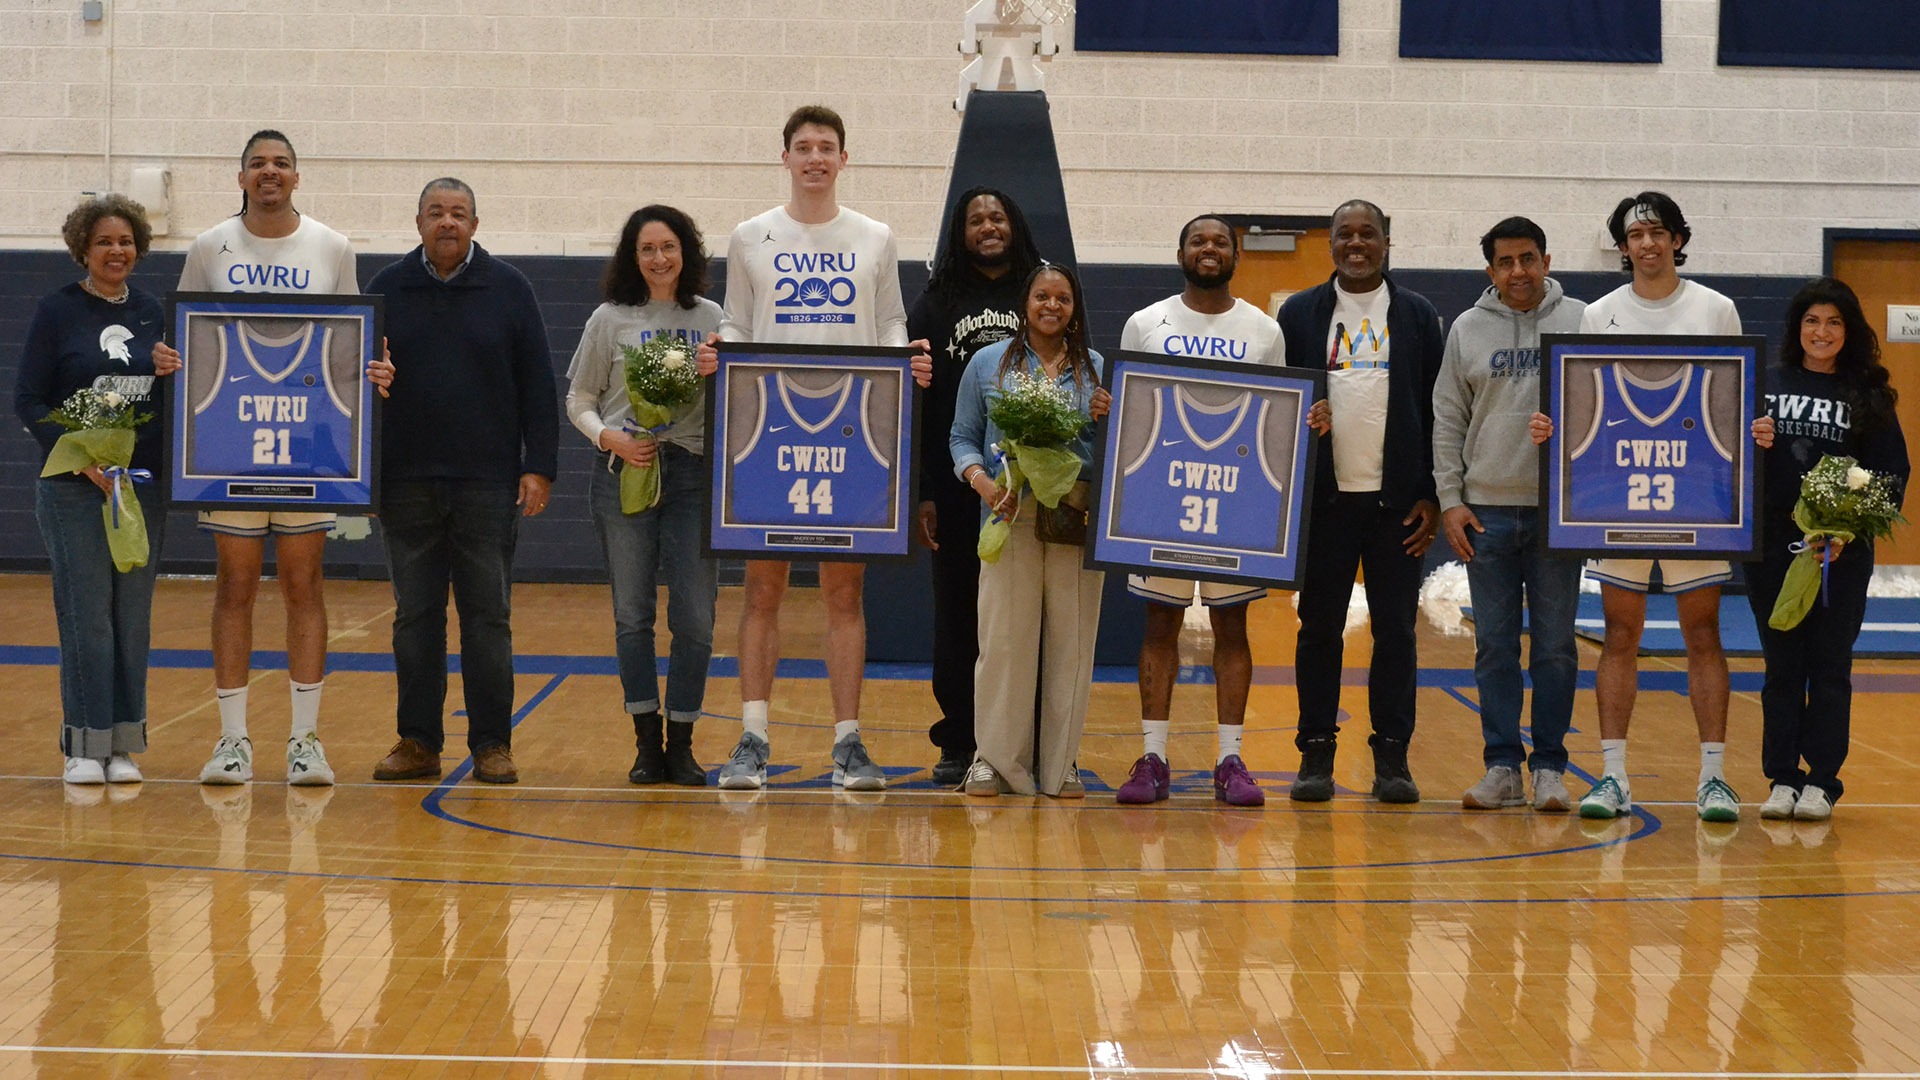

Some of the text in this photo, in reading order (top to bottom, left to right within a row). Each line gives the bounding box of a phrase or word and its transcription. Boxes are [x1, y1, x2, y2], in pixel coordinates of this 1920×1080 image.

[228, 263, 310, 290] CWRU
[774, 252, 856, 273] CWRU
[775, 276, 856, 308] 200
[790, 314, 811, 323] 1826
[820, 314, 843, 322] 2026
[955, 307, 1020, 345] Worldwid
[1905, 312, 1919, 322] No
[1163, 335, 1248, 361] CWRU
[238, 395, 308, 423] CWRU
[1777, 420, 1845, 443] SKETBALL
[253, 428, 292, 465] 21
[777, 445, 847, 473] CWRU
[1615, 439, 1688, 468] CWRU
[1168, 459, 1240, 493] CWRU
[788, 478, 833, 515] 44
[1628, 473, 1675, 511] 23
[1179, 495, 1219, 535] 31
